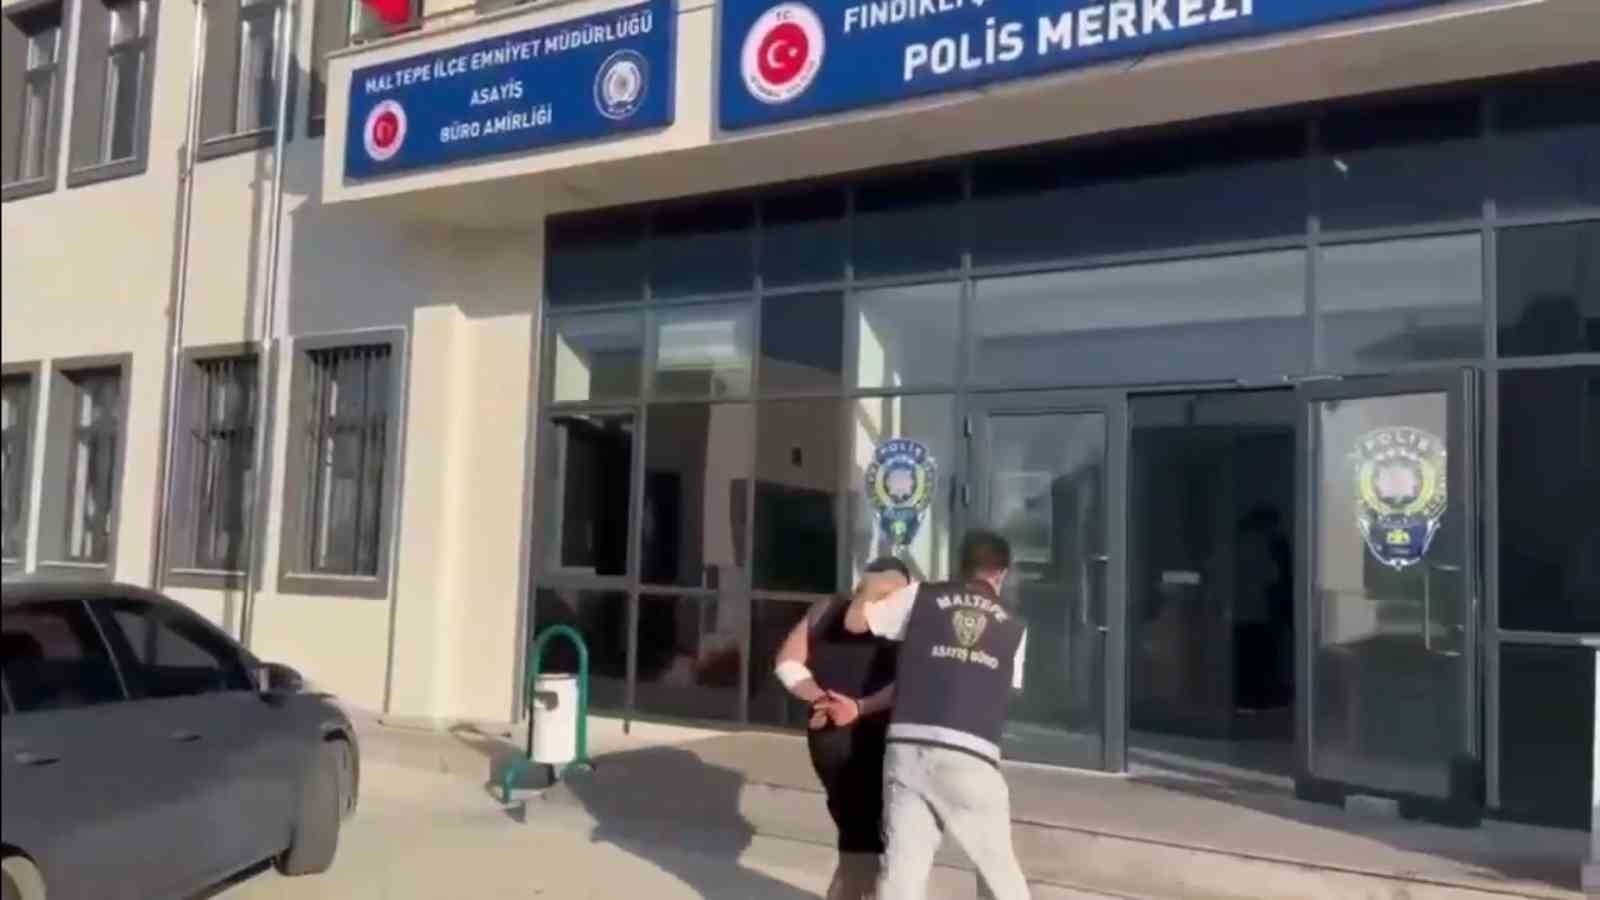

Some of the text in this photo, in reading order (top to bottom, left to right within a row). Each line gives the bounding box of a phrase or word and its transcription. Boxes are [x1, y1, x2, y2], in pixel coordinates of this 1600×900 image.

[844, 0, 964, 33] FINDIKL
[365, 10, 653, 94] MALTEPE İLÇE EMNİYET MÜDÜRLÜĞÜ
[903, 29, 1024, 81] POLİS
[440, 103, 552, 143] BÜRO AMİRLİĞİ
